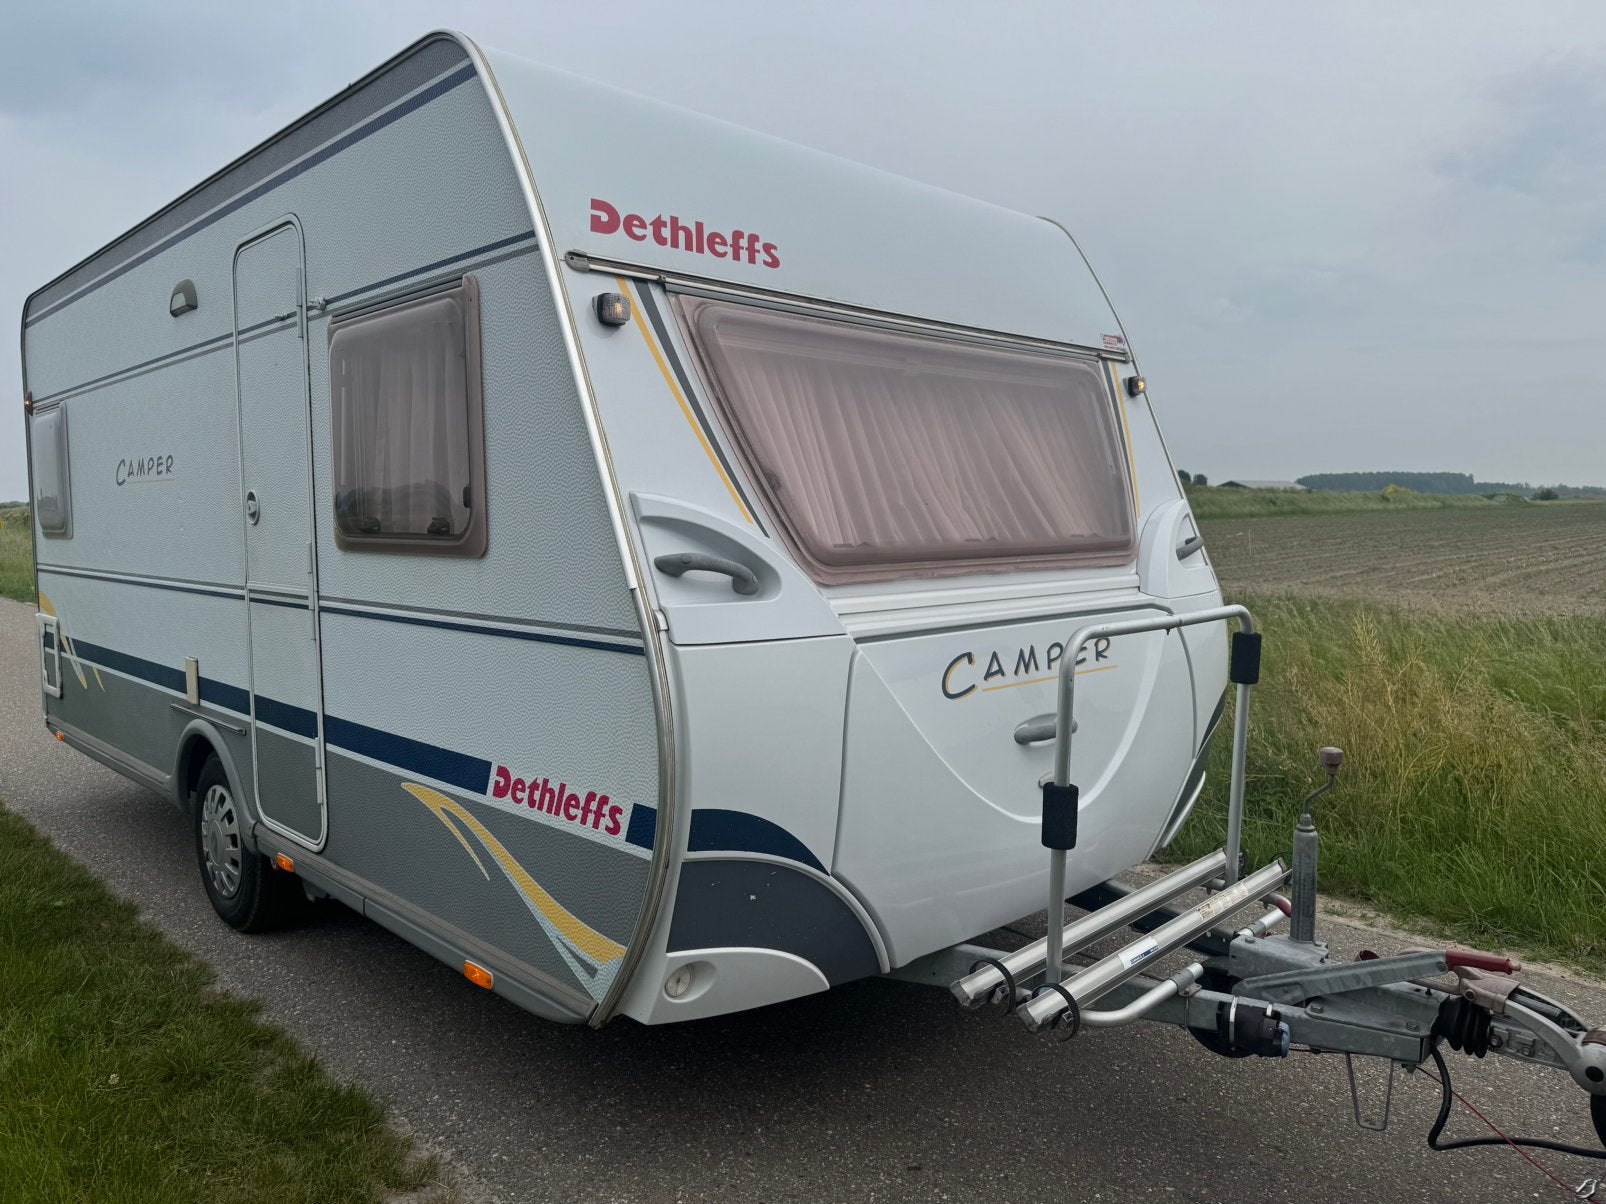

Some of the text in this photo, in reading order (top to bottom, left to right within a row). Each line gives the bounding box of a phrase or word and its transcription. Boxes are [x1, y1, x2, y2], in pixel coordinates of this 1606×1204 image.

[590, 198, 781, 269] Dethleffs
[116, 454, 174, 486] CAMPER
[492, 764, 623, 836] Dethleffs
